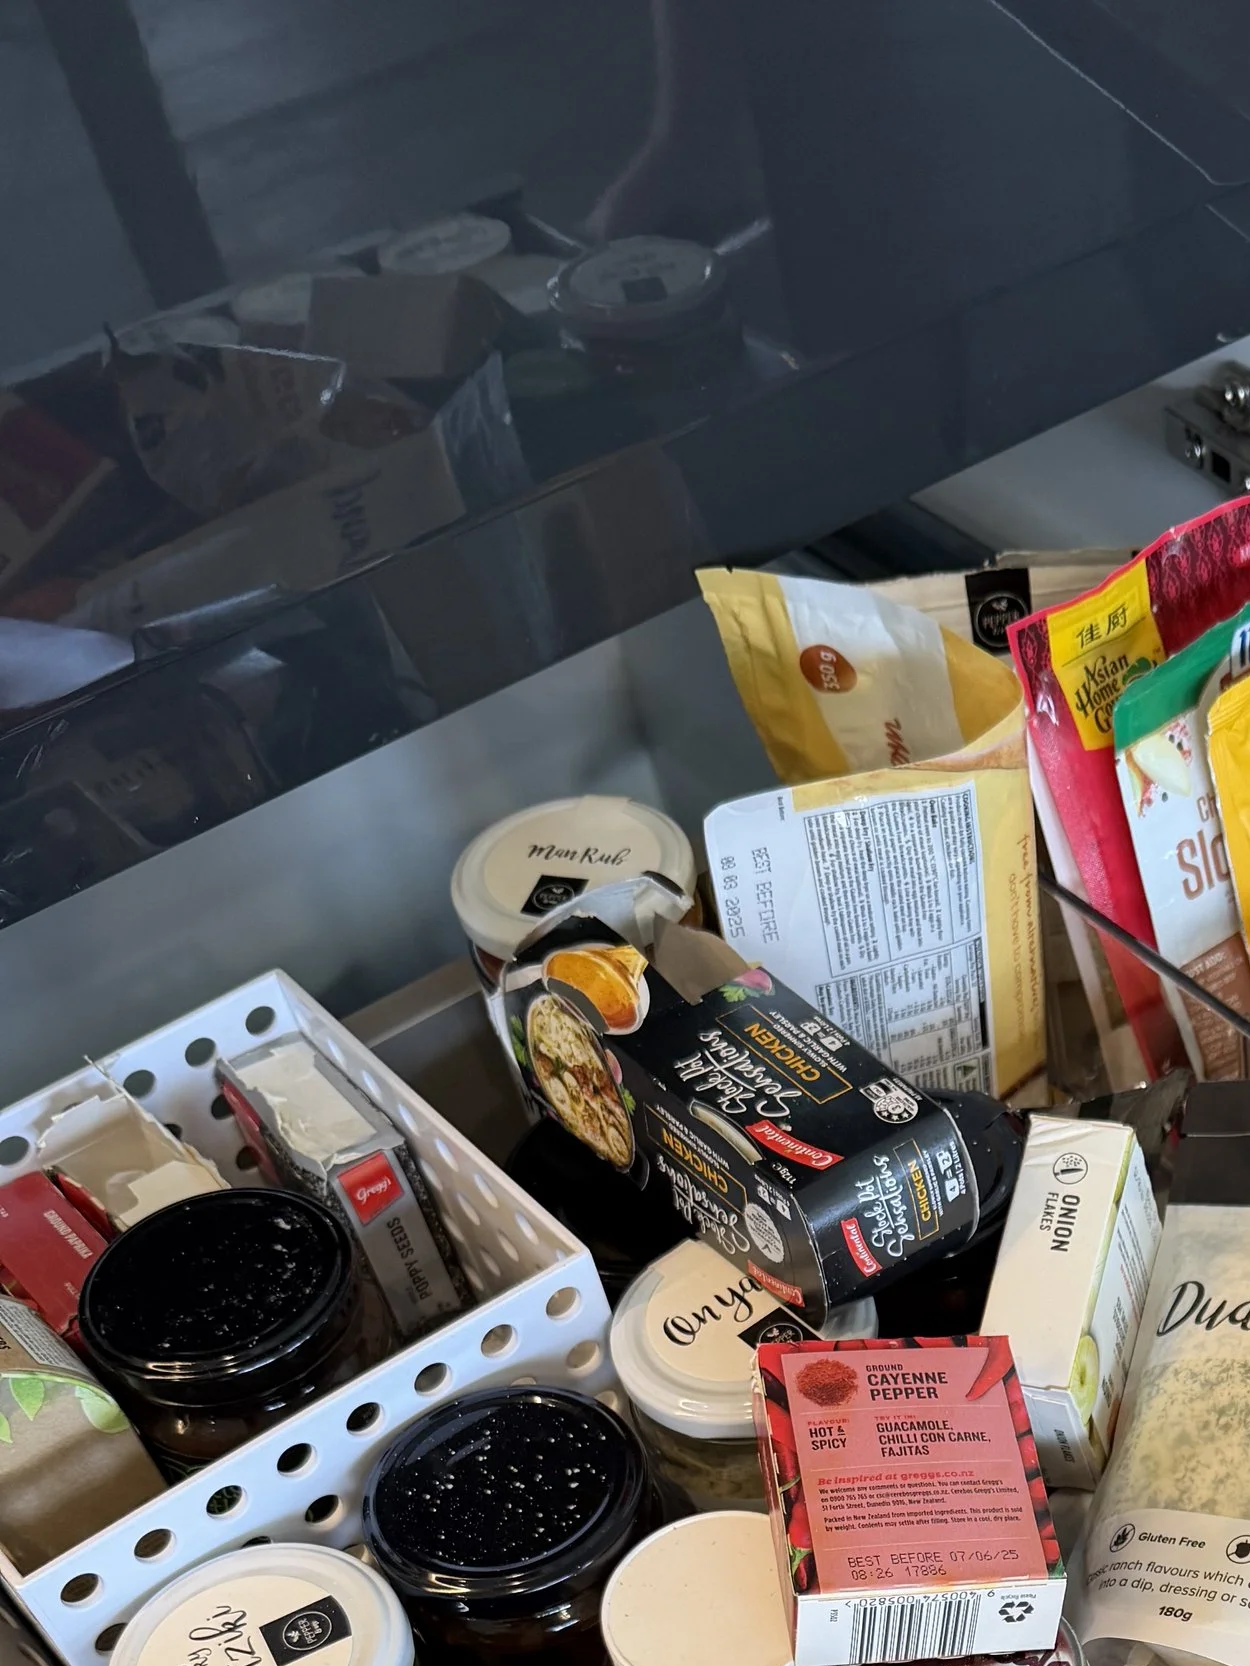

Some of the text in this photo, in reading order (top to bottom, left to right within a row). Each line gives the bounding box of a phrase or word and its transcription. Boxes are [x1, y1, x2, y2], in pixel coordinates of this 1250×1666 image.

[1083, 653, 1130, 690] Asian
[1075, 679, 1119, 718] Home
[527, 844, 631, 867] Man Rub
[751, 847, 779, 944] BEST BEFORE
[741, 1023, 823, 1087] CHICKEN
[671, 1048, 755, 1113] Stock Pot
[683, 1031, 805, 1117] Sensations
[757, 1125, 833, 1165] Continental
[907, 1159, 934, 1222] CHICKEN
[852, 1174, 895, 1248] Stock Pot
[863, 1150, 919, 1259] Sensations
[1039, 1191, 1059, 1231] FLAKES
[1051, 1194, 1080, 1252] ONION
[387, 1216, 433, 1301] POPPY SEEDS
[847, 1221, 876, 1272] Continental
[663, 1304, 722, 1346] On
[865, 1362, 903, 1372] GROUND
[868, 1372, 948, 1386] CAYENNE
[870, 1387, 938, 1401] PEPPER
[809, 1425, 845, 1438] HOT &
[876, 1420, 953, 1433] GUACAMOLE,
[879, 1431, 991, 1445] CHILLI CON CARNE,
[811, 1438, 846, 1450] SPICY
[881, 1445, 929, 1457] FAJITAS
[817, 1477, 833, 1487] Be
[834, 1473, 882, 1485] inspired
[900, 1471, 974, 1481] greggs.co.nz
[1138, 1530, 1206, 1550] Gluten Free
[847, 1549, 1019, 1568] BEST BEFORE 07/06/25
[851, 1564, 947, 1581] 08:26 17886
[1146, 1560, 1200, 1580] flavours
[1203, 1568, 1245, 1587] which
[859, 1589, 995, 1607] 9 400574 005820
[1119, 1578, 1130, 1589] a
[1131, 1575, 1156, 1595] dip,
[1158, 1577, 1218, 1603] dressing
[1220, 1590, 1237, 1603] or
[1157, 1605, 1194, 1624] 180g
